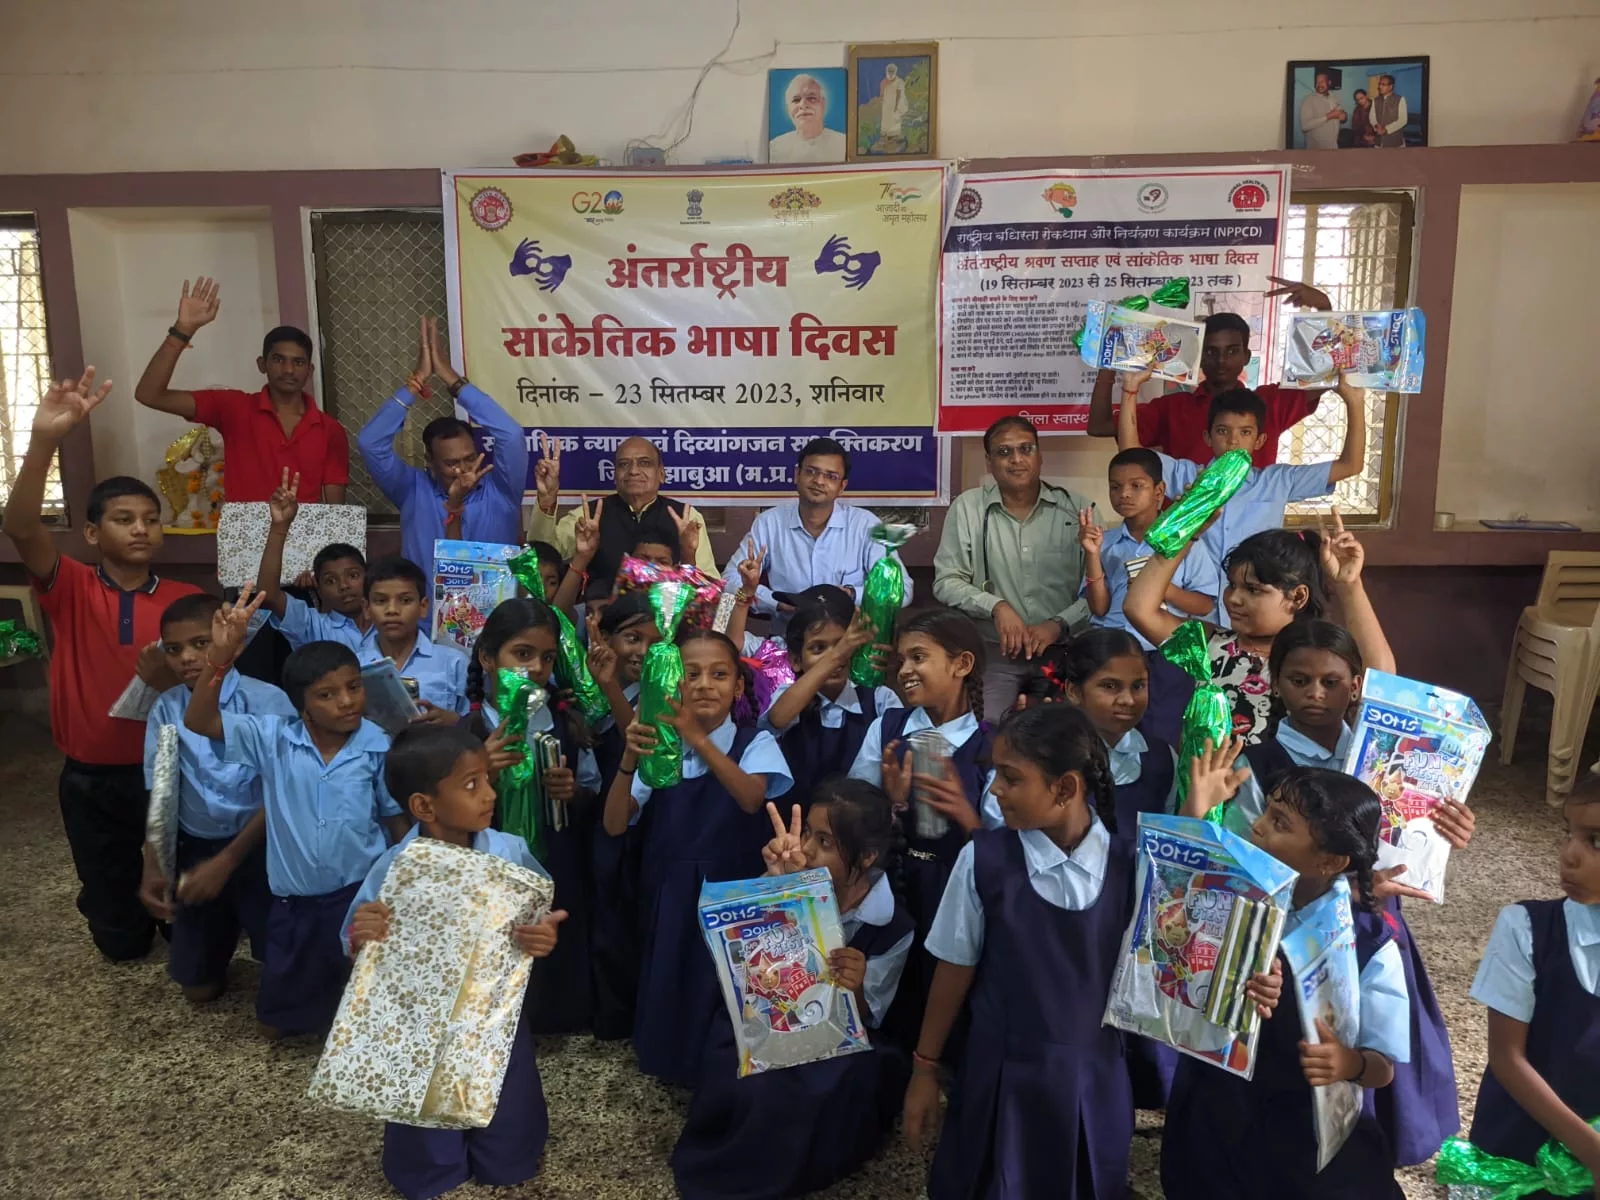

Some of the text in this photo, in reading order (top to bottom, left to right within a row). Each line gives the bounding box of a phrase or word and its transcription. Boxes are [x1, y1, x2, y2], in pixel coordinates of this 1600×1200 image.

[995, 228, 1039, 241] बधिरता
[1090, 225, 1111, 239] और
[1162, 225, 1210, 239] कार्यक्रम
[1213, 225, 1263, 238] (NPPCD)
[1025, 255, 1056, 268] श्रवण
[1061, 254, 1099, 268] सप्ताह
[1105, 252, 1121, 267] एवं
[1126, 250, 1184, 267] सांकेतिक
[1189, 253, 1220, 266] भाषा
[1224, 249, 1260, 265] दिवस
[605, 242, 790, 300] अंतर्राष्ट्रीय
[1001, 274, 1055, 290] सितम्बर
[1059, 277, 1084, 289] 2023
[1087, 273, 1100, 287] से
[1104, 276, 1118, 287] 25
[1207, 274, 1234, 288] तक
[501, 312, 898, 361] सांकेतिक भाषा दिवस
[516, 377, 580, 407] दिनांक
[615, 383, 642, 404] 23
[650, 377, 726, 406] सितम्बर
[735, 382, 801, 409] 2023,
[809, 376, 885, 406] शनिवार
[673, 428, 786, 455] दिव्यांगजन
[439, 562, 471, 574] DOMS
[1367, 707, 1419, 732] DOMS
[1403, 750, 1441, 770] FUN
[1145, 837, 1205, 865] DOMS
[1189, 888, 1234, 911] FUN
[705, 904, 757, 927] DOMS
